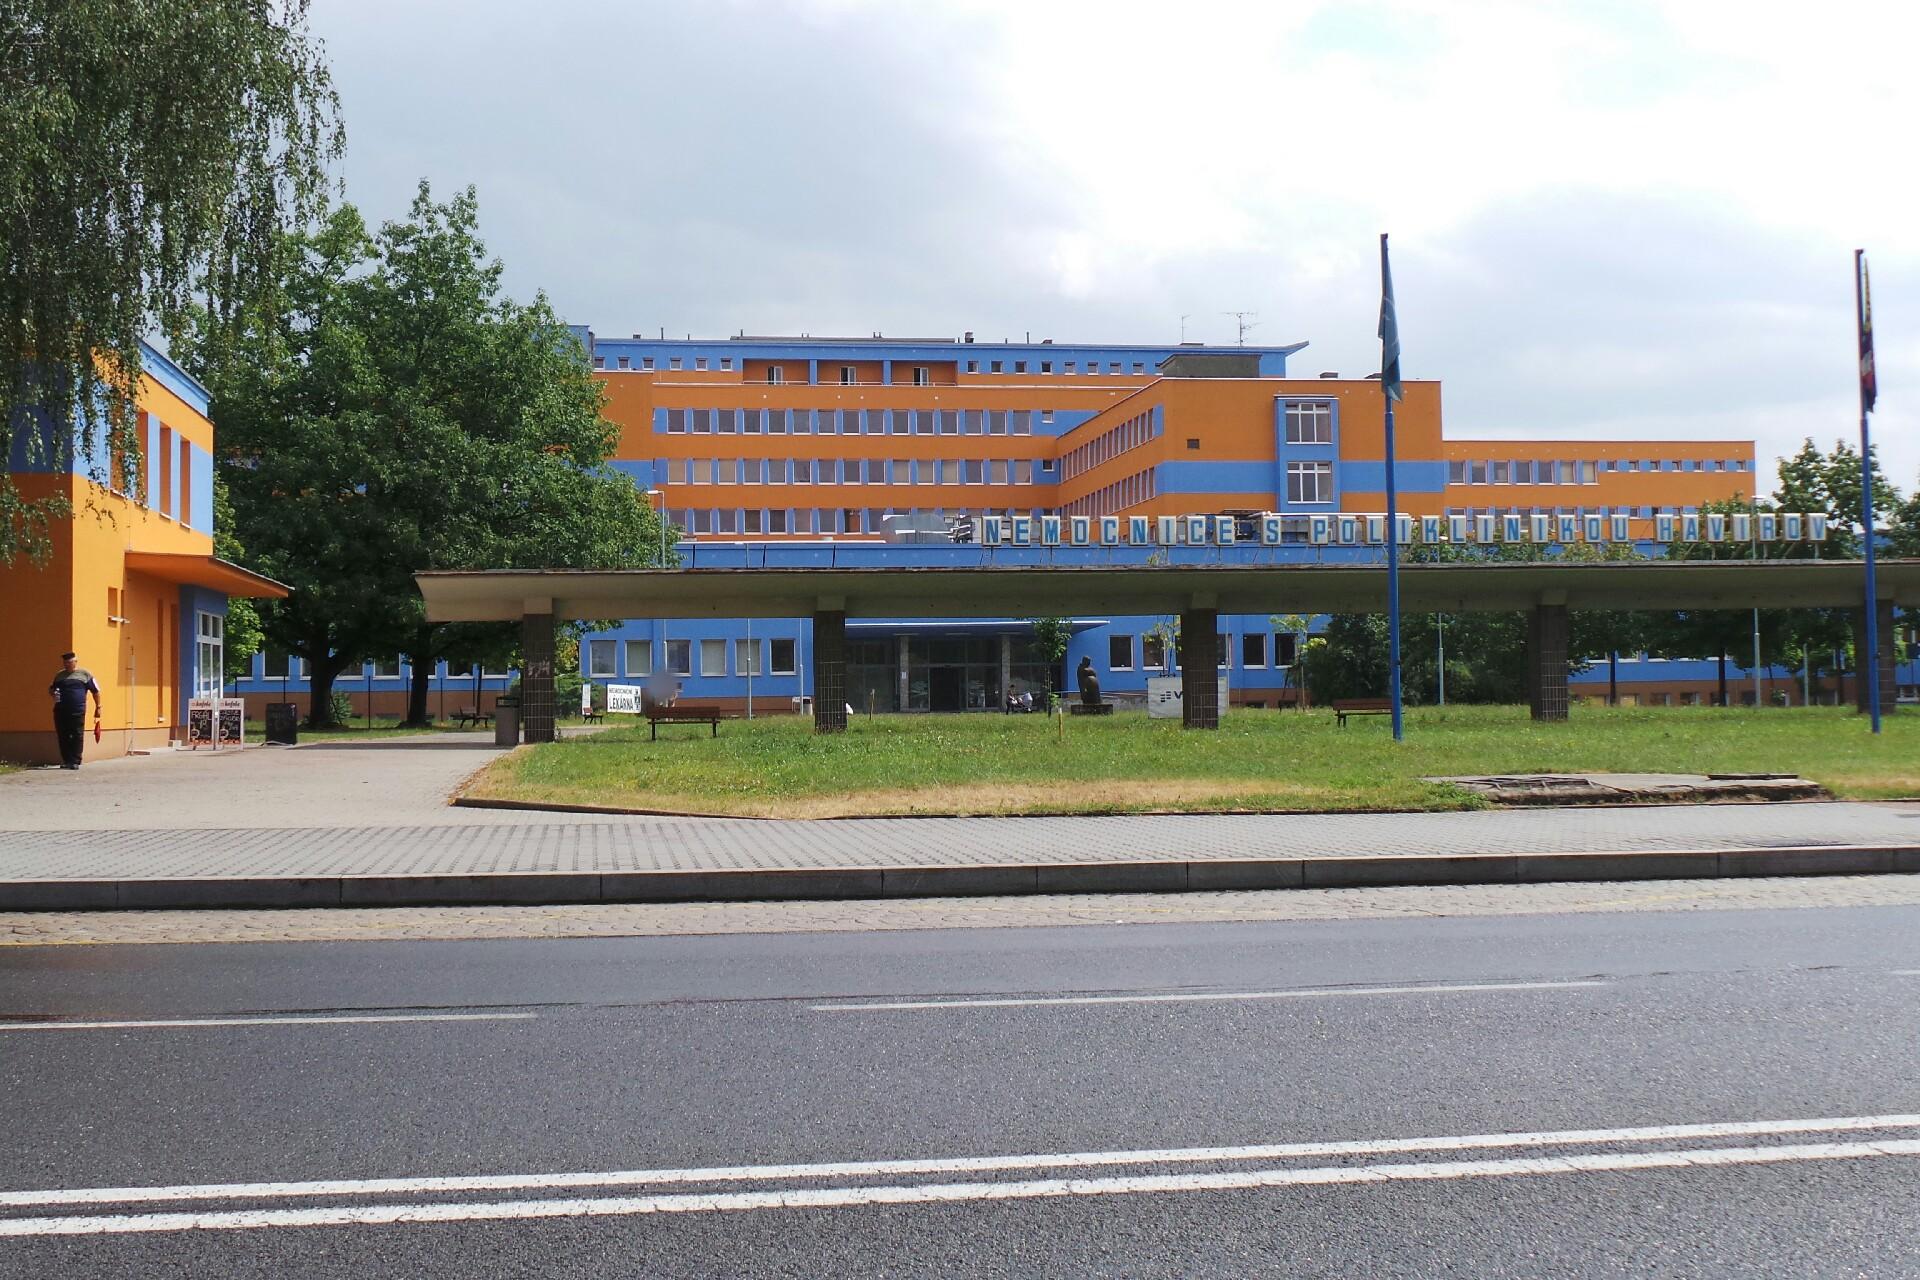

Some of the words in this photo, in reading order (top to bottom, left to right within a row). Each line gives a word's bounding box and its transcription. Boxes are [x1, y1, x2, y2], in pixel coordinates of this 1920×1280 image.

[985, 518, 1233, 544] NEMOCNICE
[1266, 519, 1280, 542] S
[1313, 517, 1627, 543] POLIKLINIKOU
